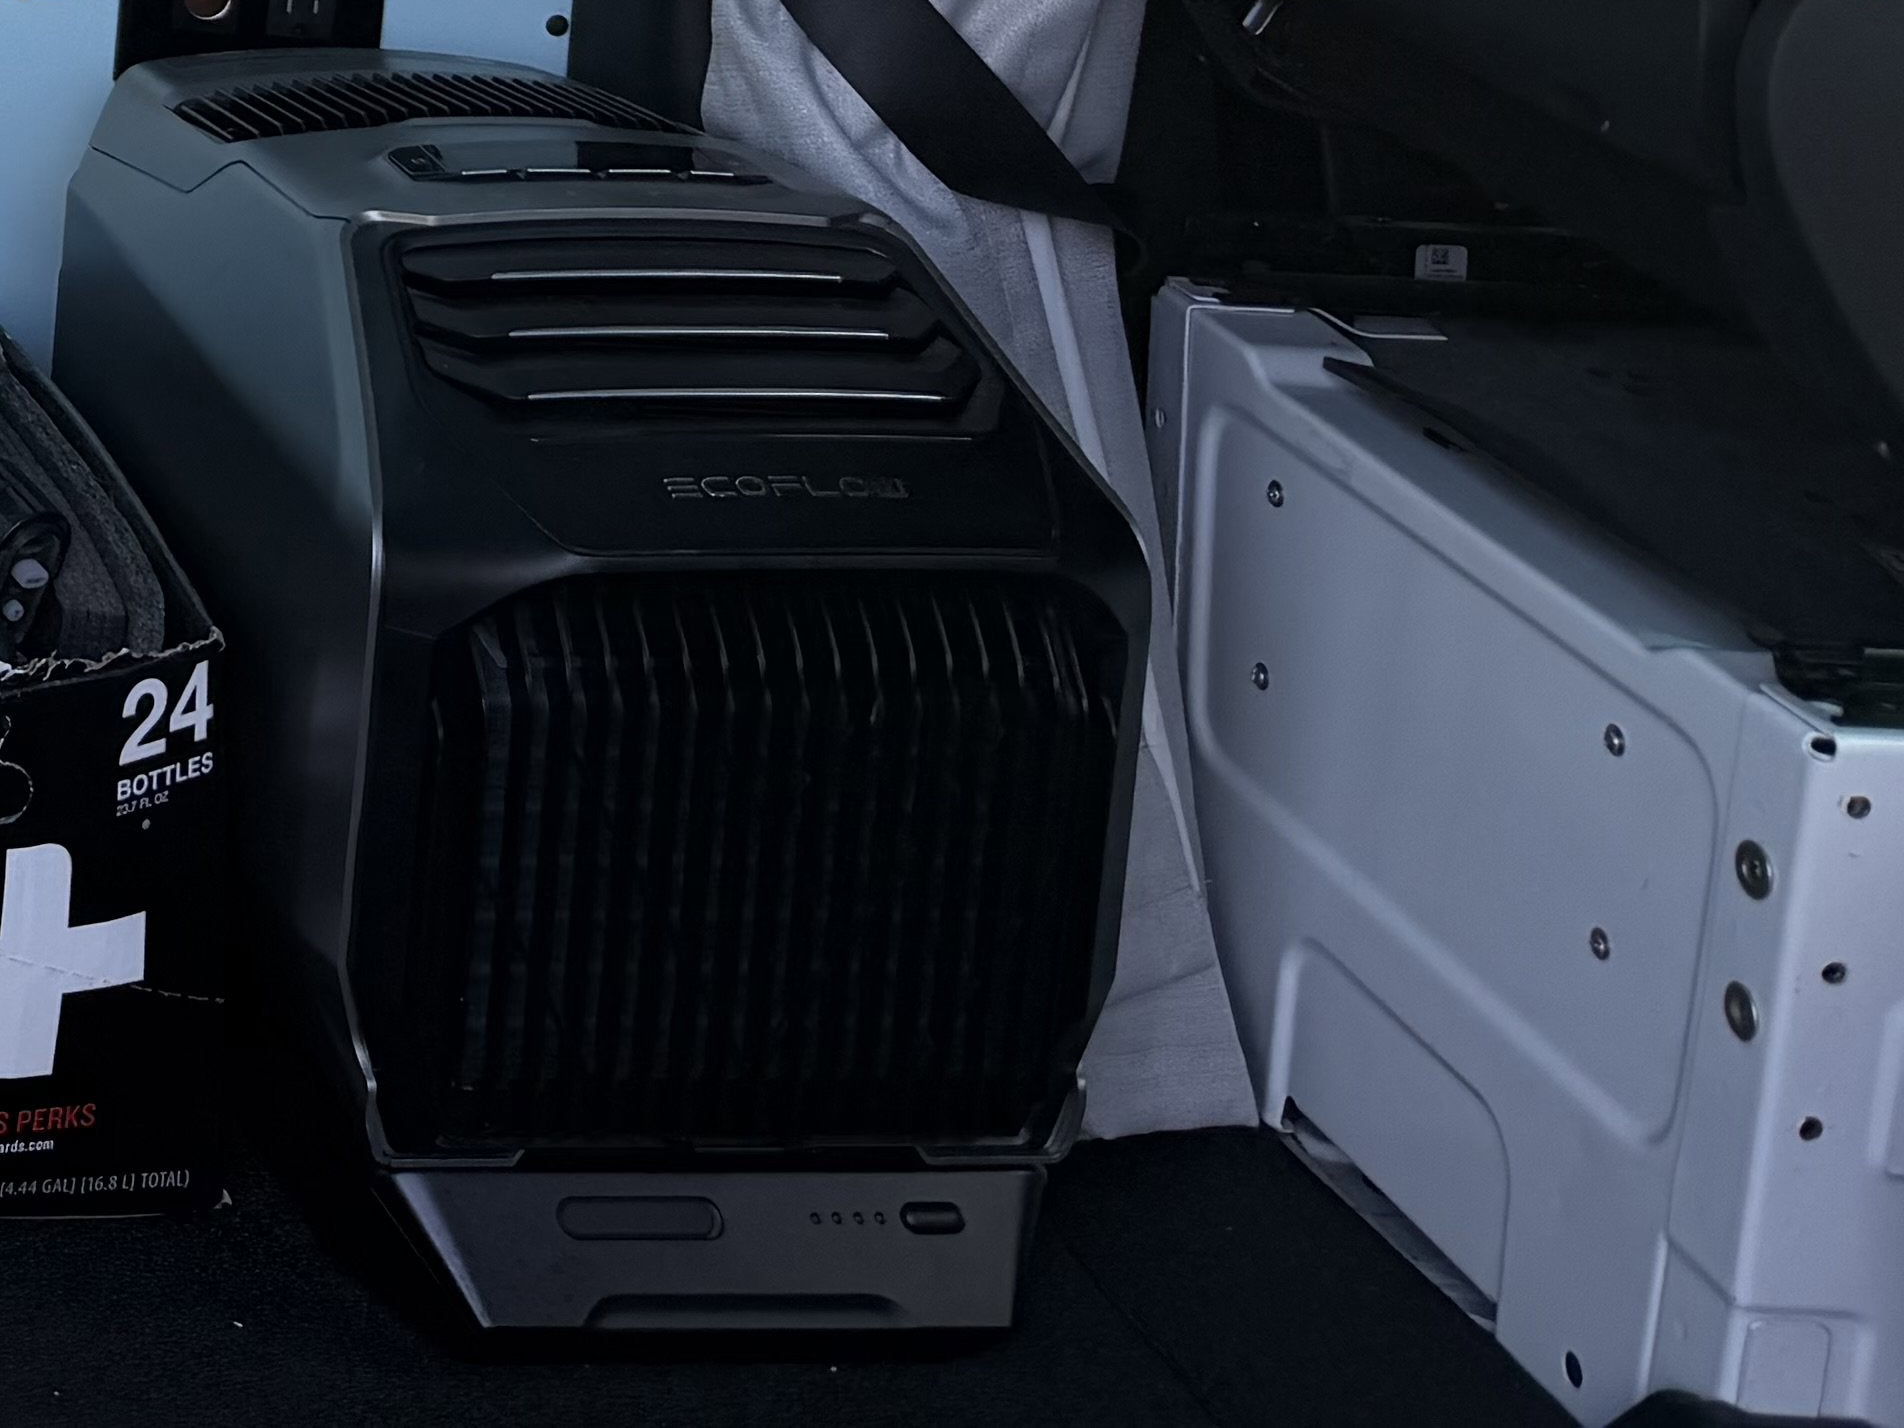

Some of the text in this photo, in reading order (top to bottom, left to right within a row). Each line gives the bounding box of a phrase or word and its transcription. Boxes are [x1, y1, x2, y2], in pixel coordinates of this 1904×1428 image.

[119, 659, 214, 767] 24
[117, 751, 213, 801] BOTTLES
[16, 1102, 97, 1133] PERKS
[141, 1169, 190, 1189] TOTAL)
